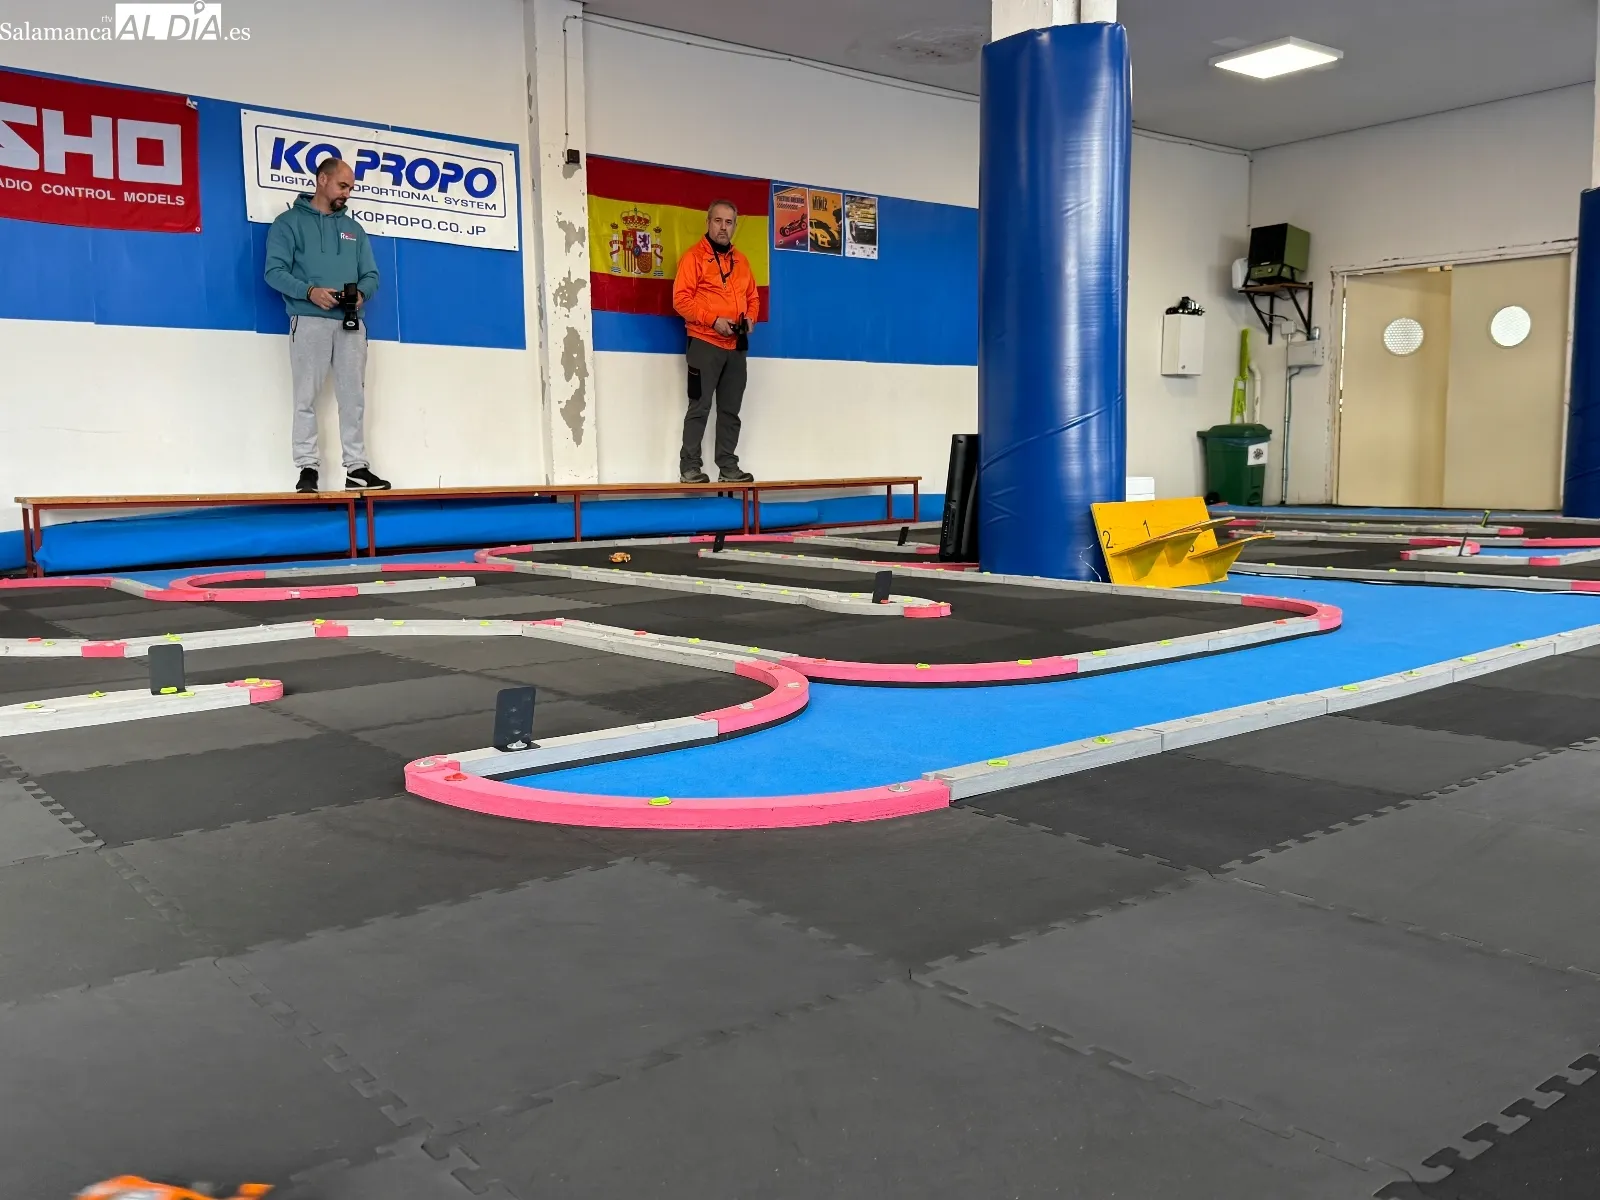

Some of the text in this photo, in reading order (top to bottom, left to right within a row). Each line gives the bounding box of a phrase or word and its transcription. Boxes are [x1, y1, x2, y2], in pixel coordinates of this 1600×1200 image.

[354, 148, 497, 199] PROPO
[41, 183, 116, 201] CONTROL
[123, 191, 185, 206] MODELS
[270, 173, 497, 211] DIGITA OPORTIONAL SYSTEM
[1102, 530, 1114, 549] 2
[1142, 519, 1151, 537] 1
